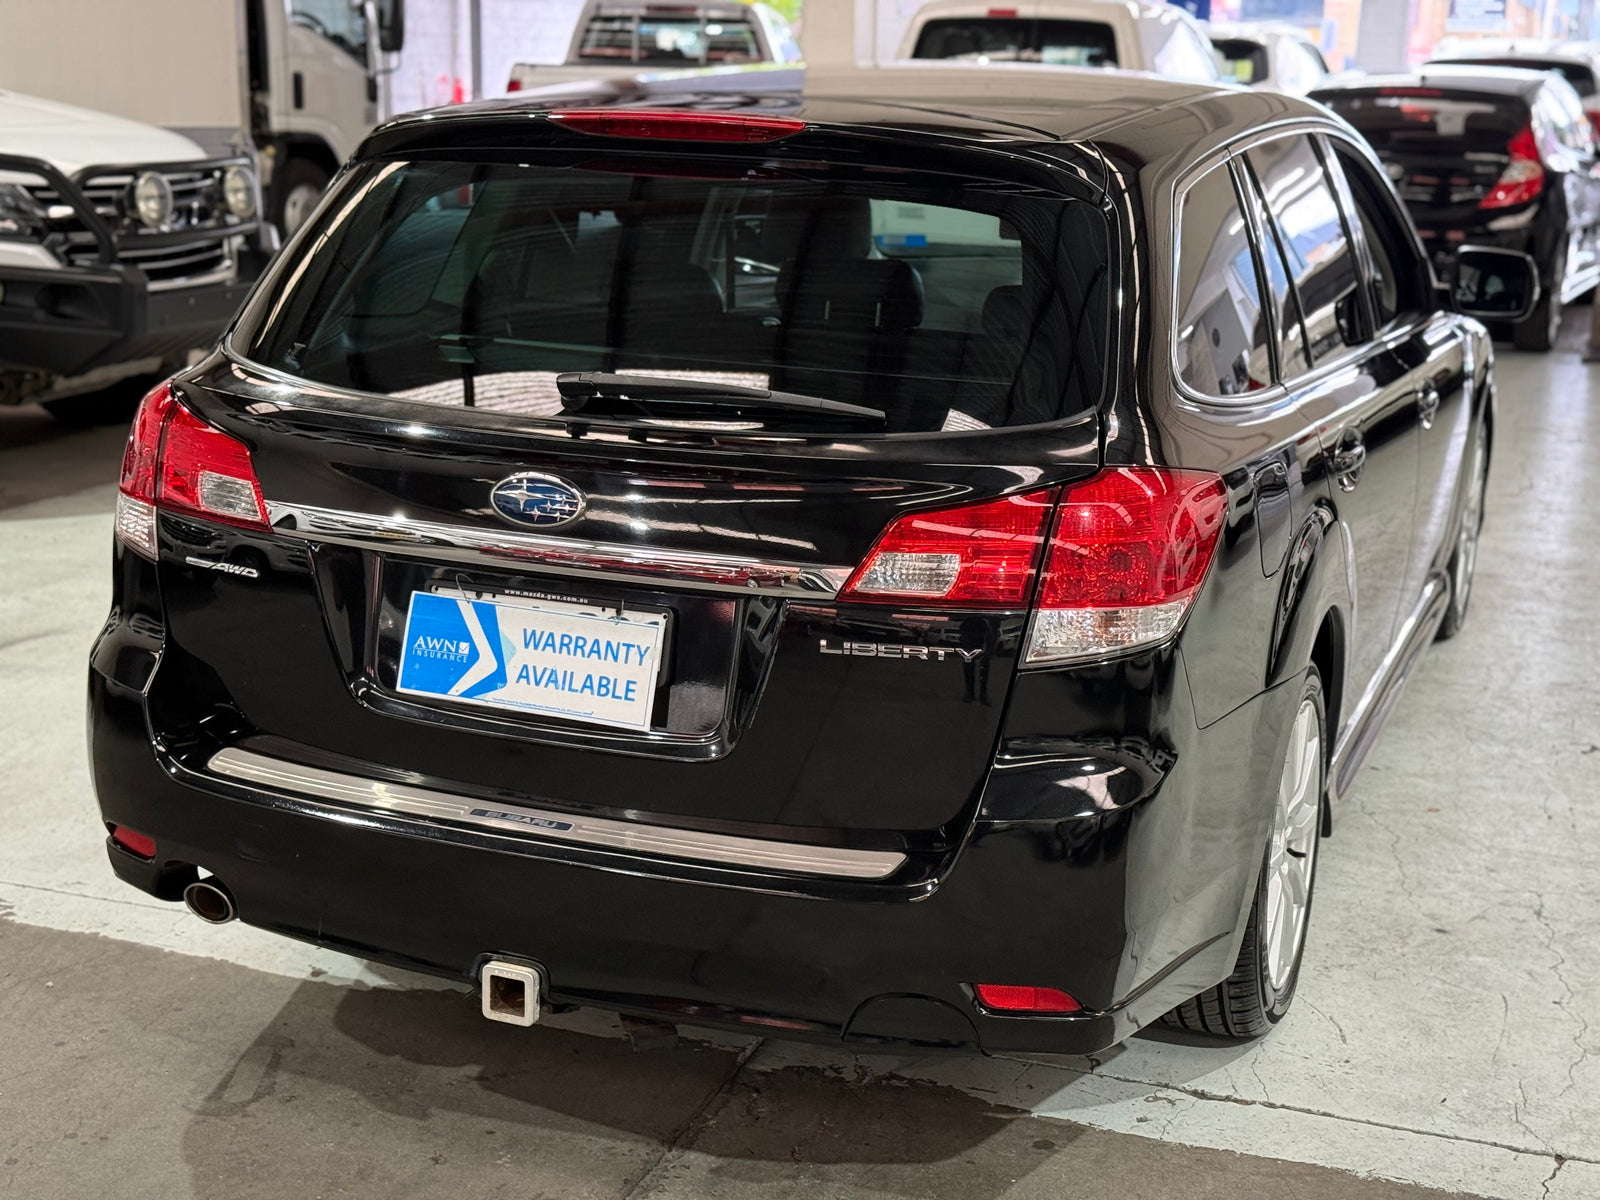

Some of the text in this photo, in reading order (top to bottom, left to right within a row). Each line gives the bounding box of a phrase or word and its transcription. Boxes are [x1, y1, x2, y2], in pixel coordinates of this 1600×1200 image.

[211, 562, 258, 578] AWD
[413, 635, 457, 652] AWN
[523, 628, 651, 666] WARRANTY
[820, 639, 982, 663] LIBERTY
[413, 649, 467, 663] INSURANCE
[515, 664, 637, 702] AVAILABLE
[485, 811, 557, 828] SUBARU
